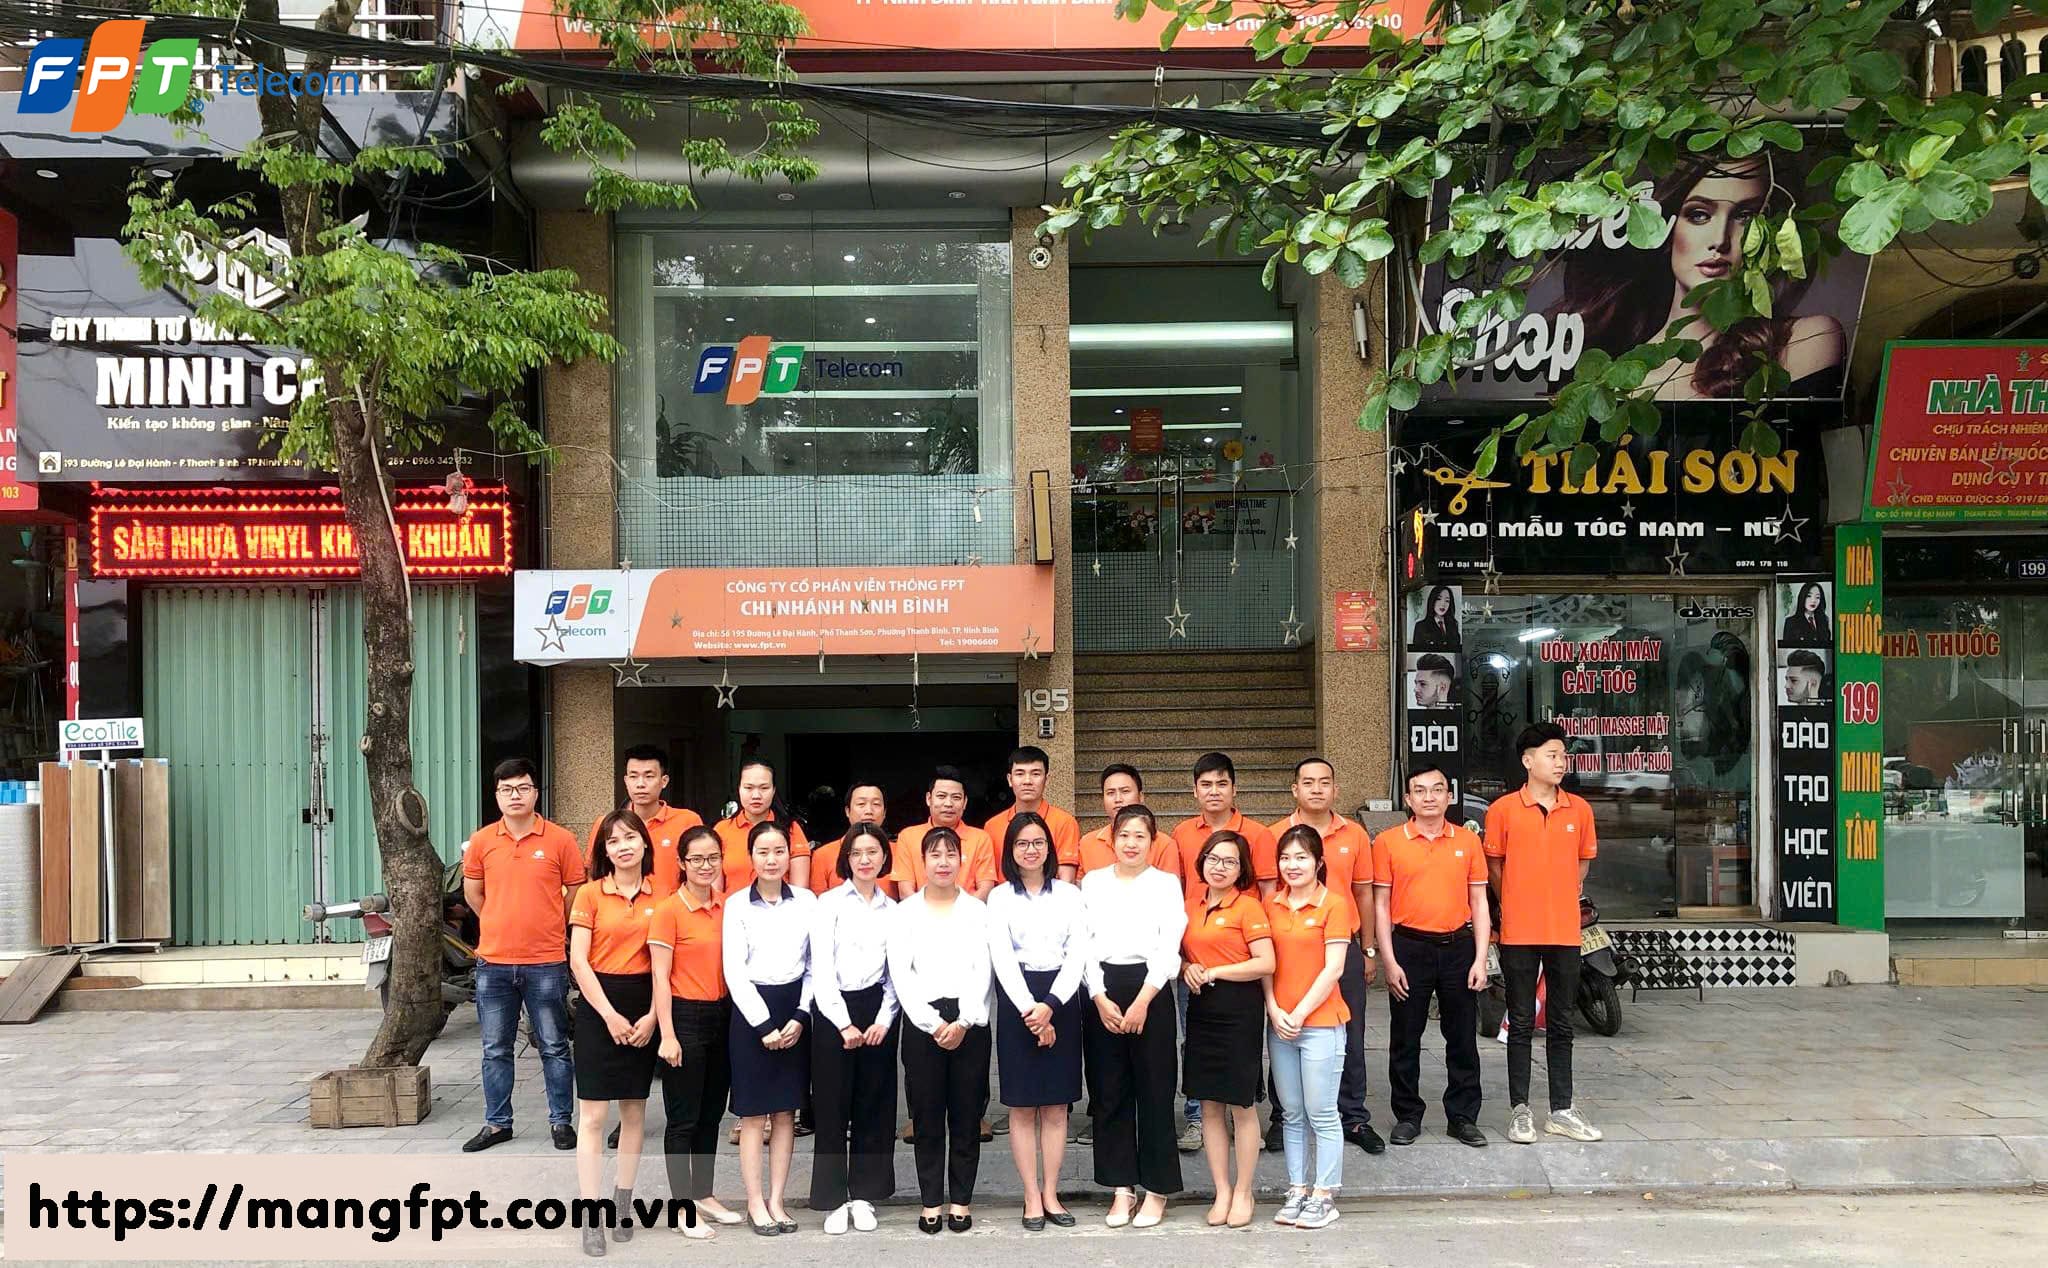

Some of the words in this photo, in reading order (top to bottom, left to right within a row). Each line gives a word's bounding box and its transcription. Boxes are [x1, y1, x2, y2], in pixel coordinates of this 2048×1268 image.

[96, 357, 245, 405] MINH
[815, 357, 904, 379] Telecom
[1926, 373, 2003, 415] NHÀ
[107, 415, 140, 430] Kiến
[145, 418, 168, 433] tạo
[172, 416, 215, 432] không
[222, 417, 251, 432] gian
[1933, 424, 1963, 438] CHỊU
[1966, 420, 2008, 435] TRÁCH
[1889, 444, 1946, 461] CHUYÊN
[1949, 443, 1978, 461] BÁN
[113, 519, 164, 560] SÀN
[171, 521, 239, 567] NHỰA
[244, 525, 313, 560] VINYL
[1437, 522, 1487, 542] TẠO
[1499, 515, 1563, 538] MẪU
[1574, 517, 1626, 538] TÓC
[1639, 522, 1704, 538] NAM
[1846, 537, 1874, 586] NHÀ
[2021, 563, 2046, 576] 199
[727, 580, 767, 593] CÔNG
[769, 581, 786, 593] TY
[941, 579, 965, 592] FPT
[740, 600, 772, 616] CHI
[776, 598, 844, 616] NHÁNH
[903, 596, 949, 614] BÌNH
[1839, 600, 1883, 654] THUỐC
[1927, 624, 2000, 658] THUỐC
[734, 641, 786, 651] www.fpt.vn
[957, 638, 998, 646] 19006600
[1540, 634, 1575, 663] UỐN
[1626, 635, 1661, 662] MÁY
[1602, 664, 1636, 693] TÓC
[1023, 688, 1069, 712] 195
[1842, 681, 1880, 725] 199
[1411, 719, 1458, 751] ĐÀO
[1601, 716, 1645, 737] MASSGE
[1782, 717, 1829, 749] ĐÀO
[1576, 754, 1601, 777] MỤN
[1841, 752, 1881, 793] MINH
[1784, 775, 1829, 807] TẠO
[1784, 828, 1829, 860] HỌC
[1846, 812, 1877, 860] TÂM
